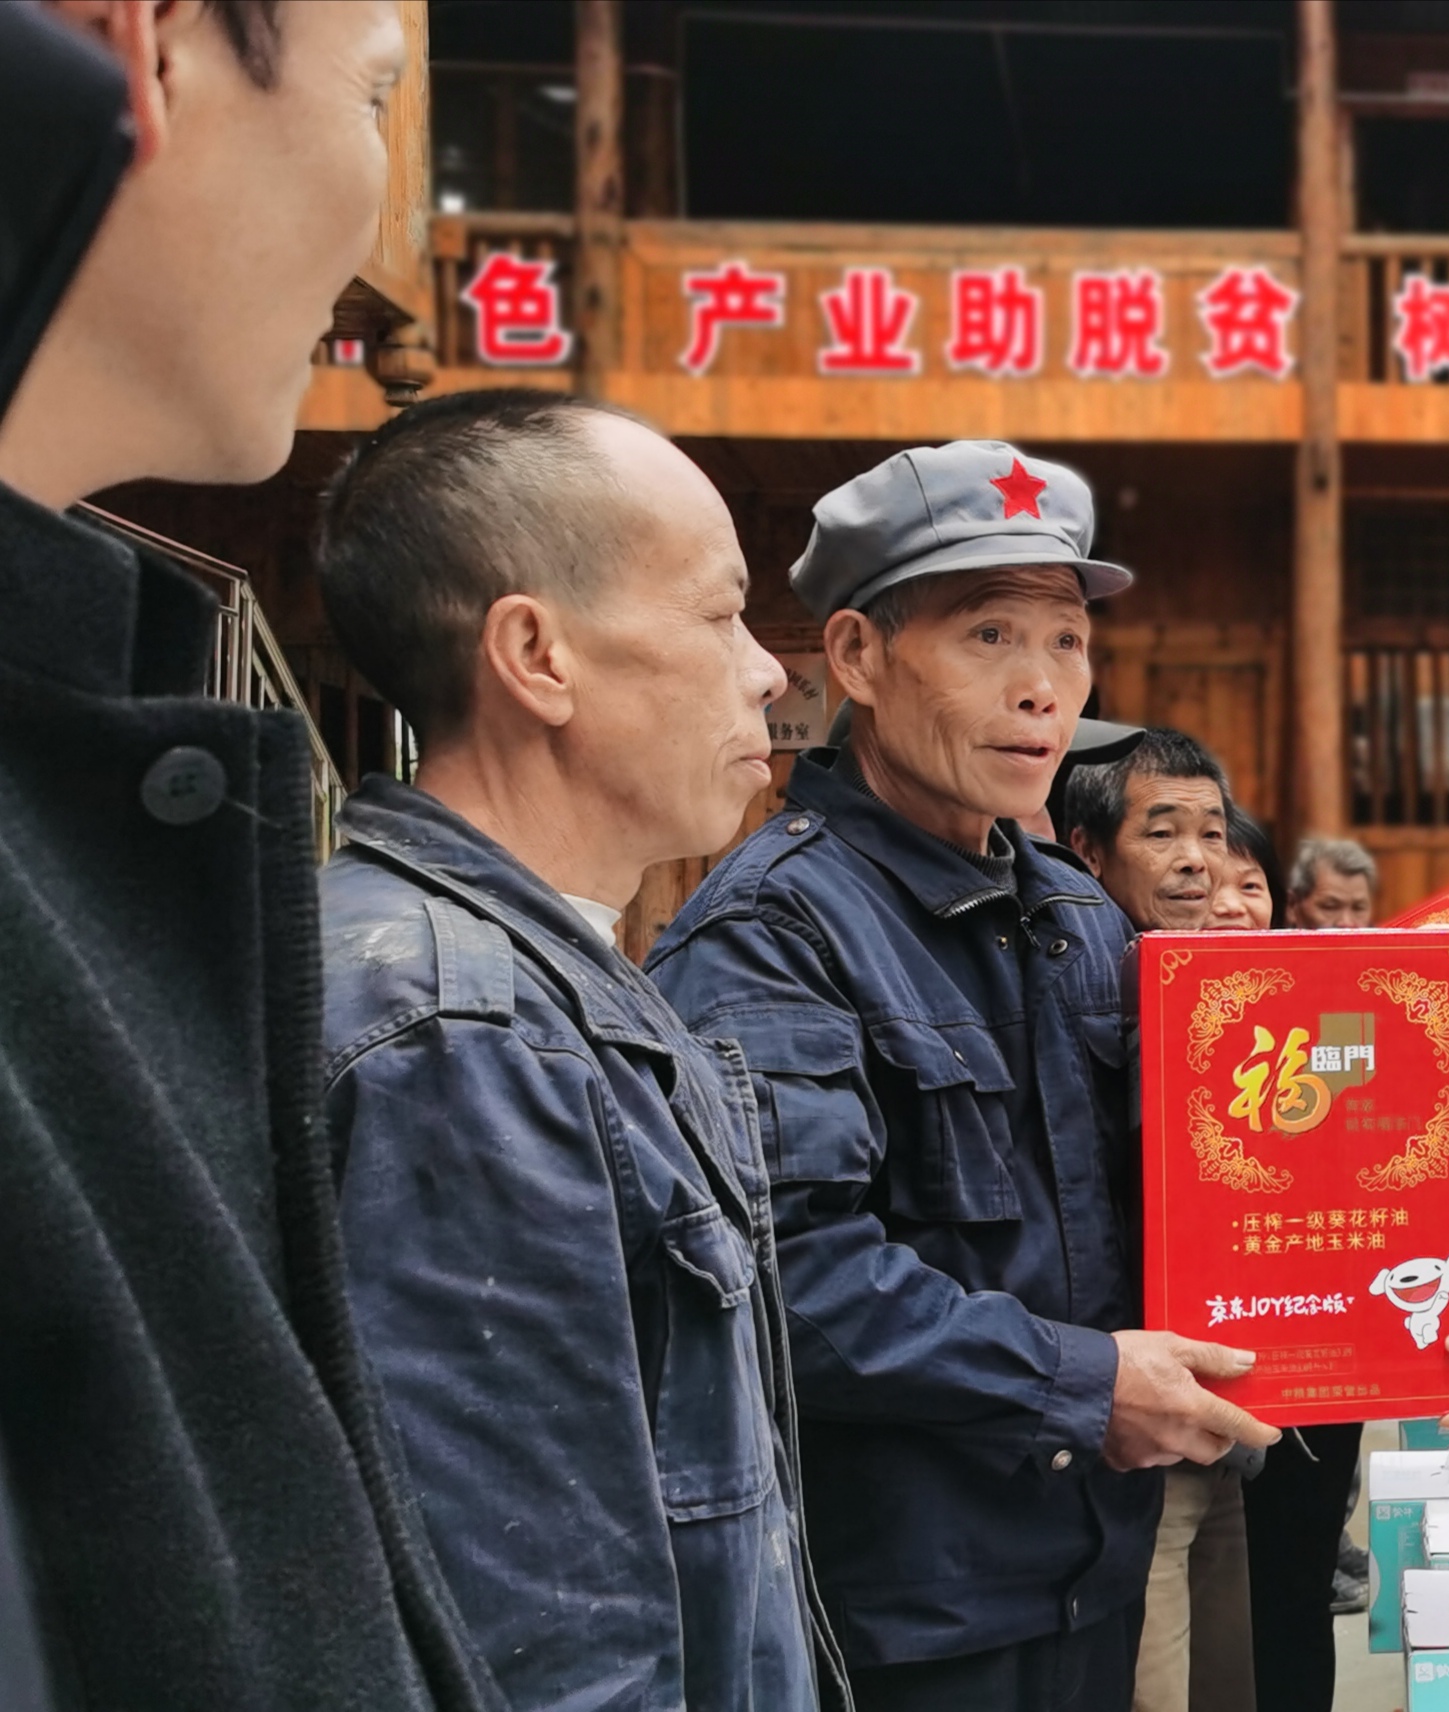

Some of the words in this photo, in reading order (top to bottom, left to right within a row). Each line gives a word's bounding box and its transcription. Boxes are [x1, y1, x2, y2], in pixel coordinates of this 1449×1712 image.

[681, 261, 1298, 378] 产业助脱贫
[1242, 1207, 1409, 1233] 压榨一级葵花籽油
[1242, 1230, 1386, 1255] 黄金产地玉米油
